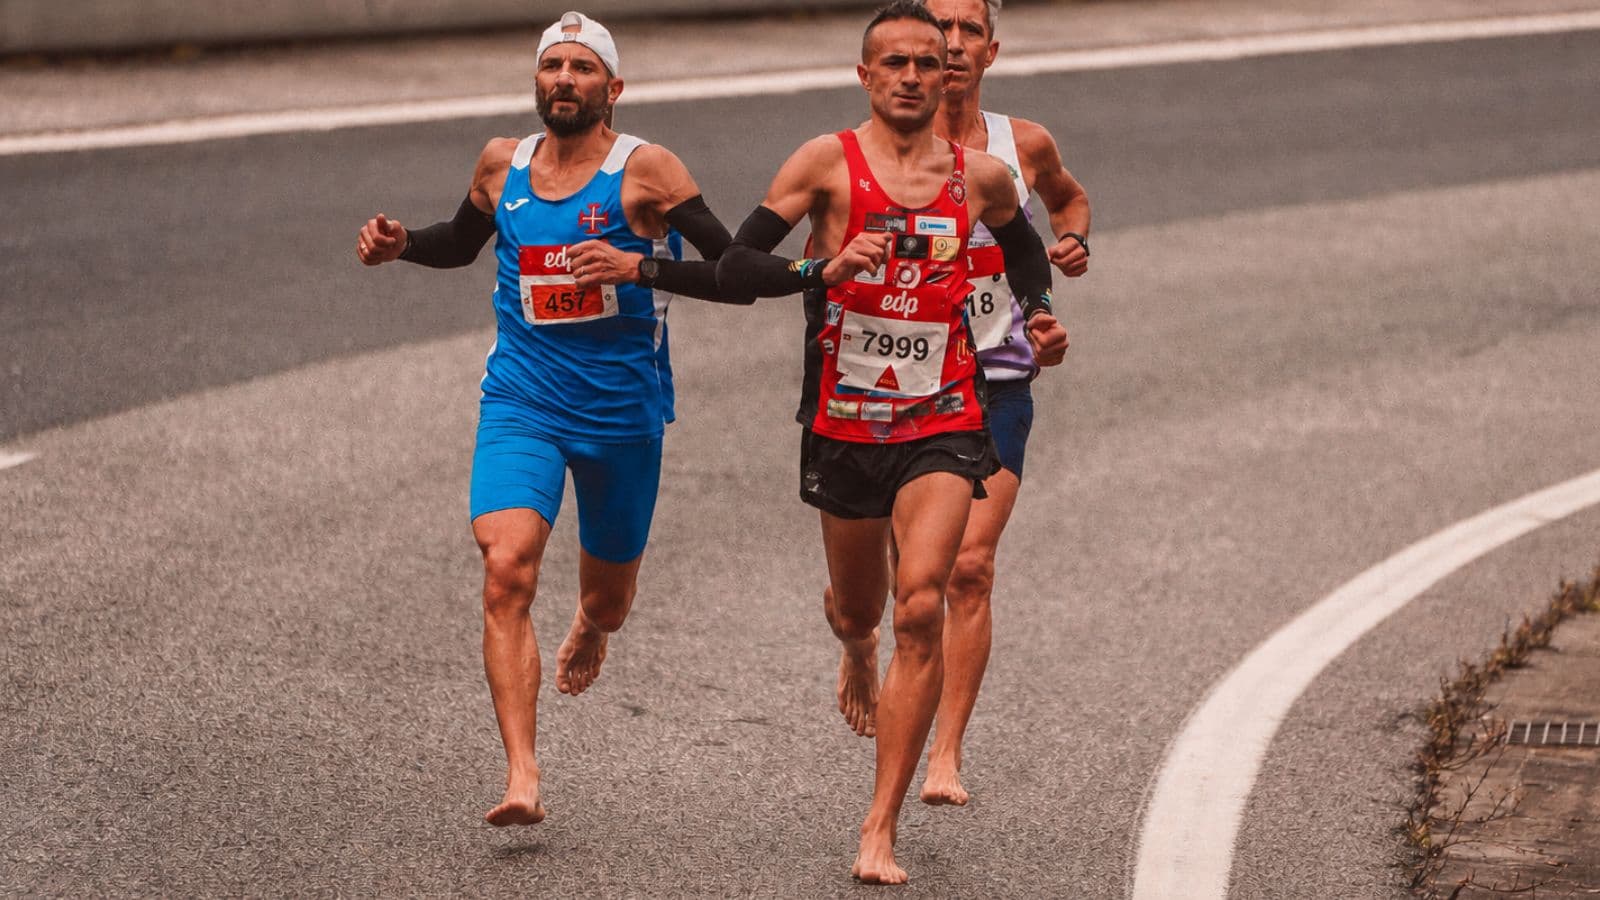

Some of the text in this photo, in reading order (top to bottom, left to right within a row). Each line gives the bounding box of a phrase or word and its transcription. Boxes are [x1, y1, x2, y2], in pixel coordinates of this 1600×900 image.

[545, 291, 586, 313] 457
[880, 290, 919, 319] edp
[861, 330, 930, 362] 7999
